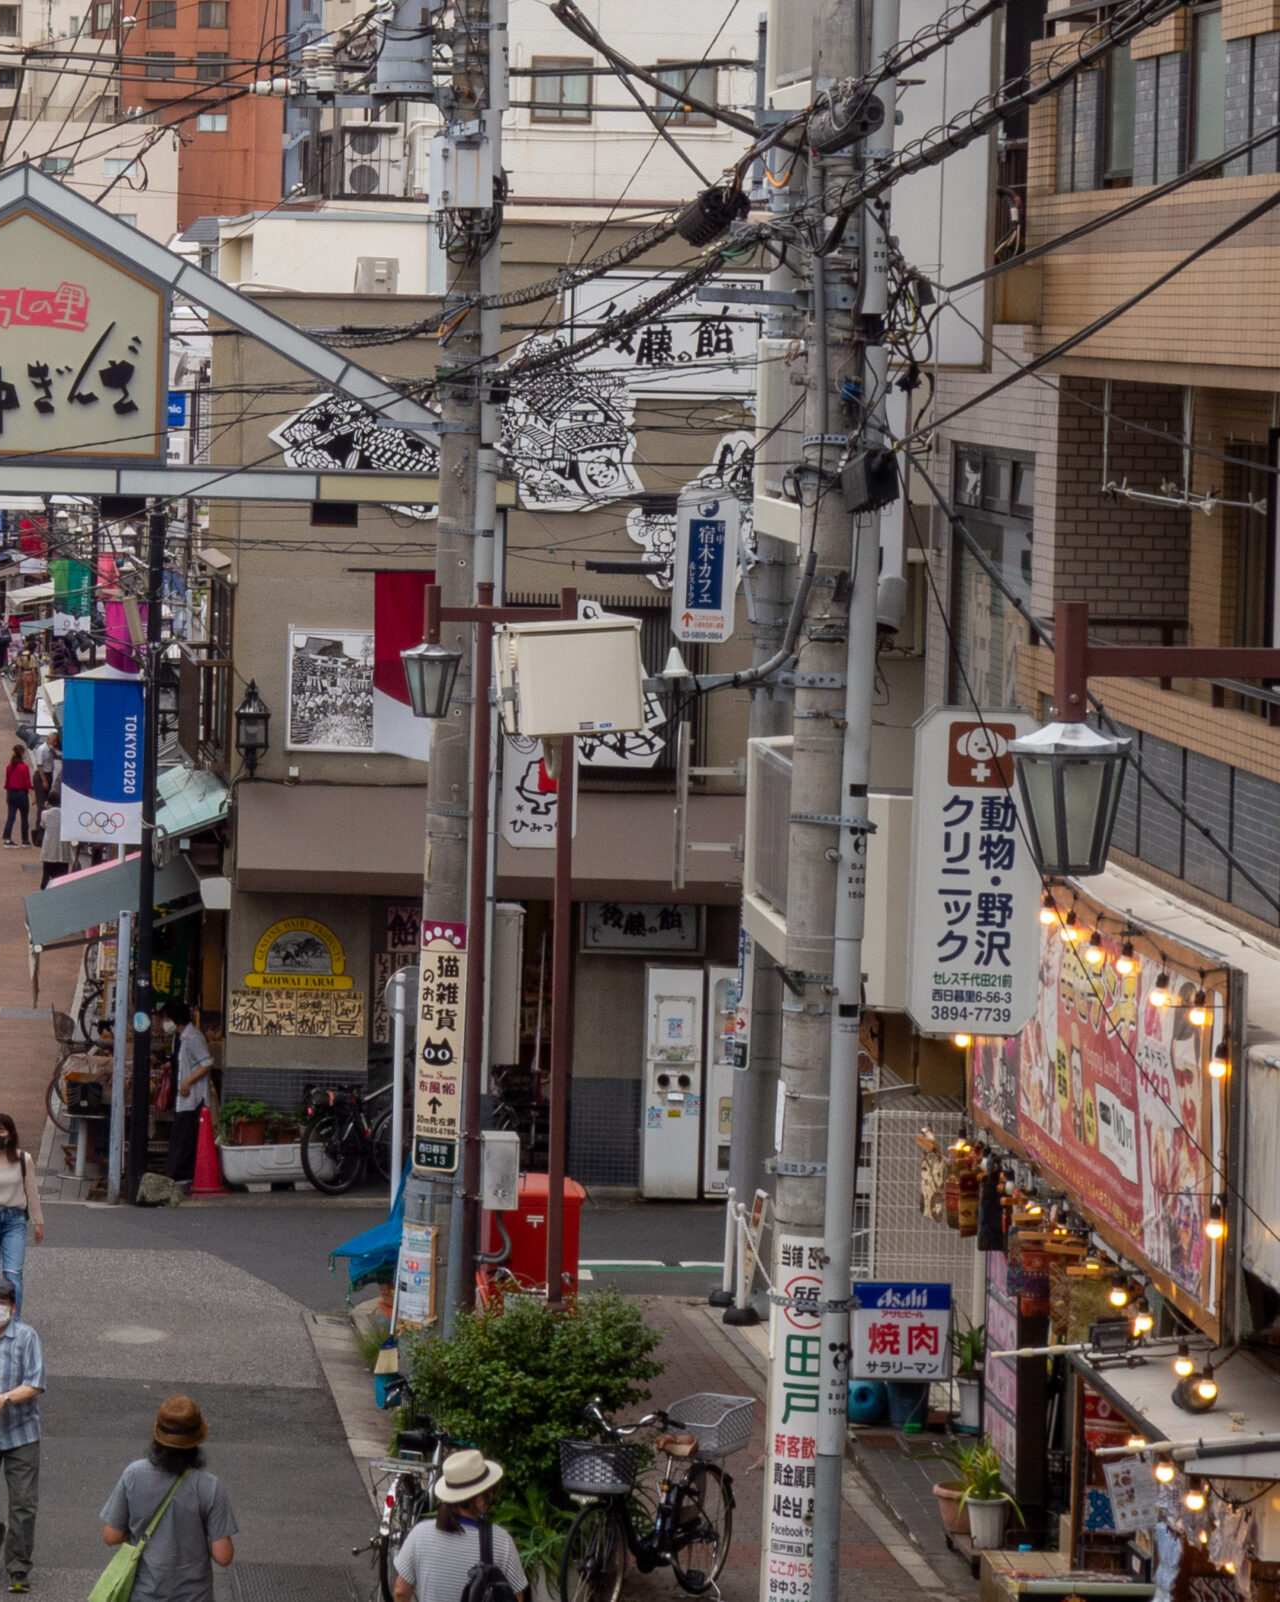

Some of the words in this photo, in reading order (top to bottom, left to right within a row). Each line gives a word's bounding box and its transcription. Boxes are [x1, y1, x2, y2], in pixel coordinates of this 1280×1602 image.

[697, 525, 716, 604] 宿木カフェ
[124, 715, 137, 760] TOKYO
[123, 761, 136, 794] 2020
[510, 819, 557, 834] ひみつ
[937, 794, 974, 964] クリニック
[975, 795, 1017, 968] 動物・野沢
[599, 902, 683, 938] 後藤の飴
[388, 913, 419, 948] 飴
[263, 976, 301, 986] KOIWAI
[305, 977, 335, 987] FARM
[933, 971, 1012, 988] セレス千代田21前
[421, 969, 435, 1022] のお店
[435, 955, 460, 1032] 猫雑貨
[932, 988, 1012, 1004] 西日暮里6-56-3
[931, 1005, 1012, 1023] 3894-7739
[333, 1020, 359, 1036] 豆
[419, 1080, 456, 1095] 布風船
[418, 1142, 449, 1155] 西日暮里
[420, 1154, 446, 1166] 3-13
[876, 1288, 928, 1308] Asahi
[881, 1310, 925, 1319] アサヒビール
[868, 1322, 939, 1356] 焼肉
[866, 1361, 939, 1374] サラリーマン
[781, 1333, 820, 1425] 田戸
[773, 1494, 803, 1519] 새손님
[771, 1522, 804, 1538] Facebook
[768, 1578, 810, 1595] 谷中3-2
